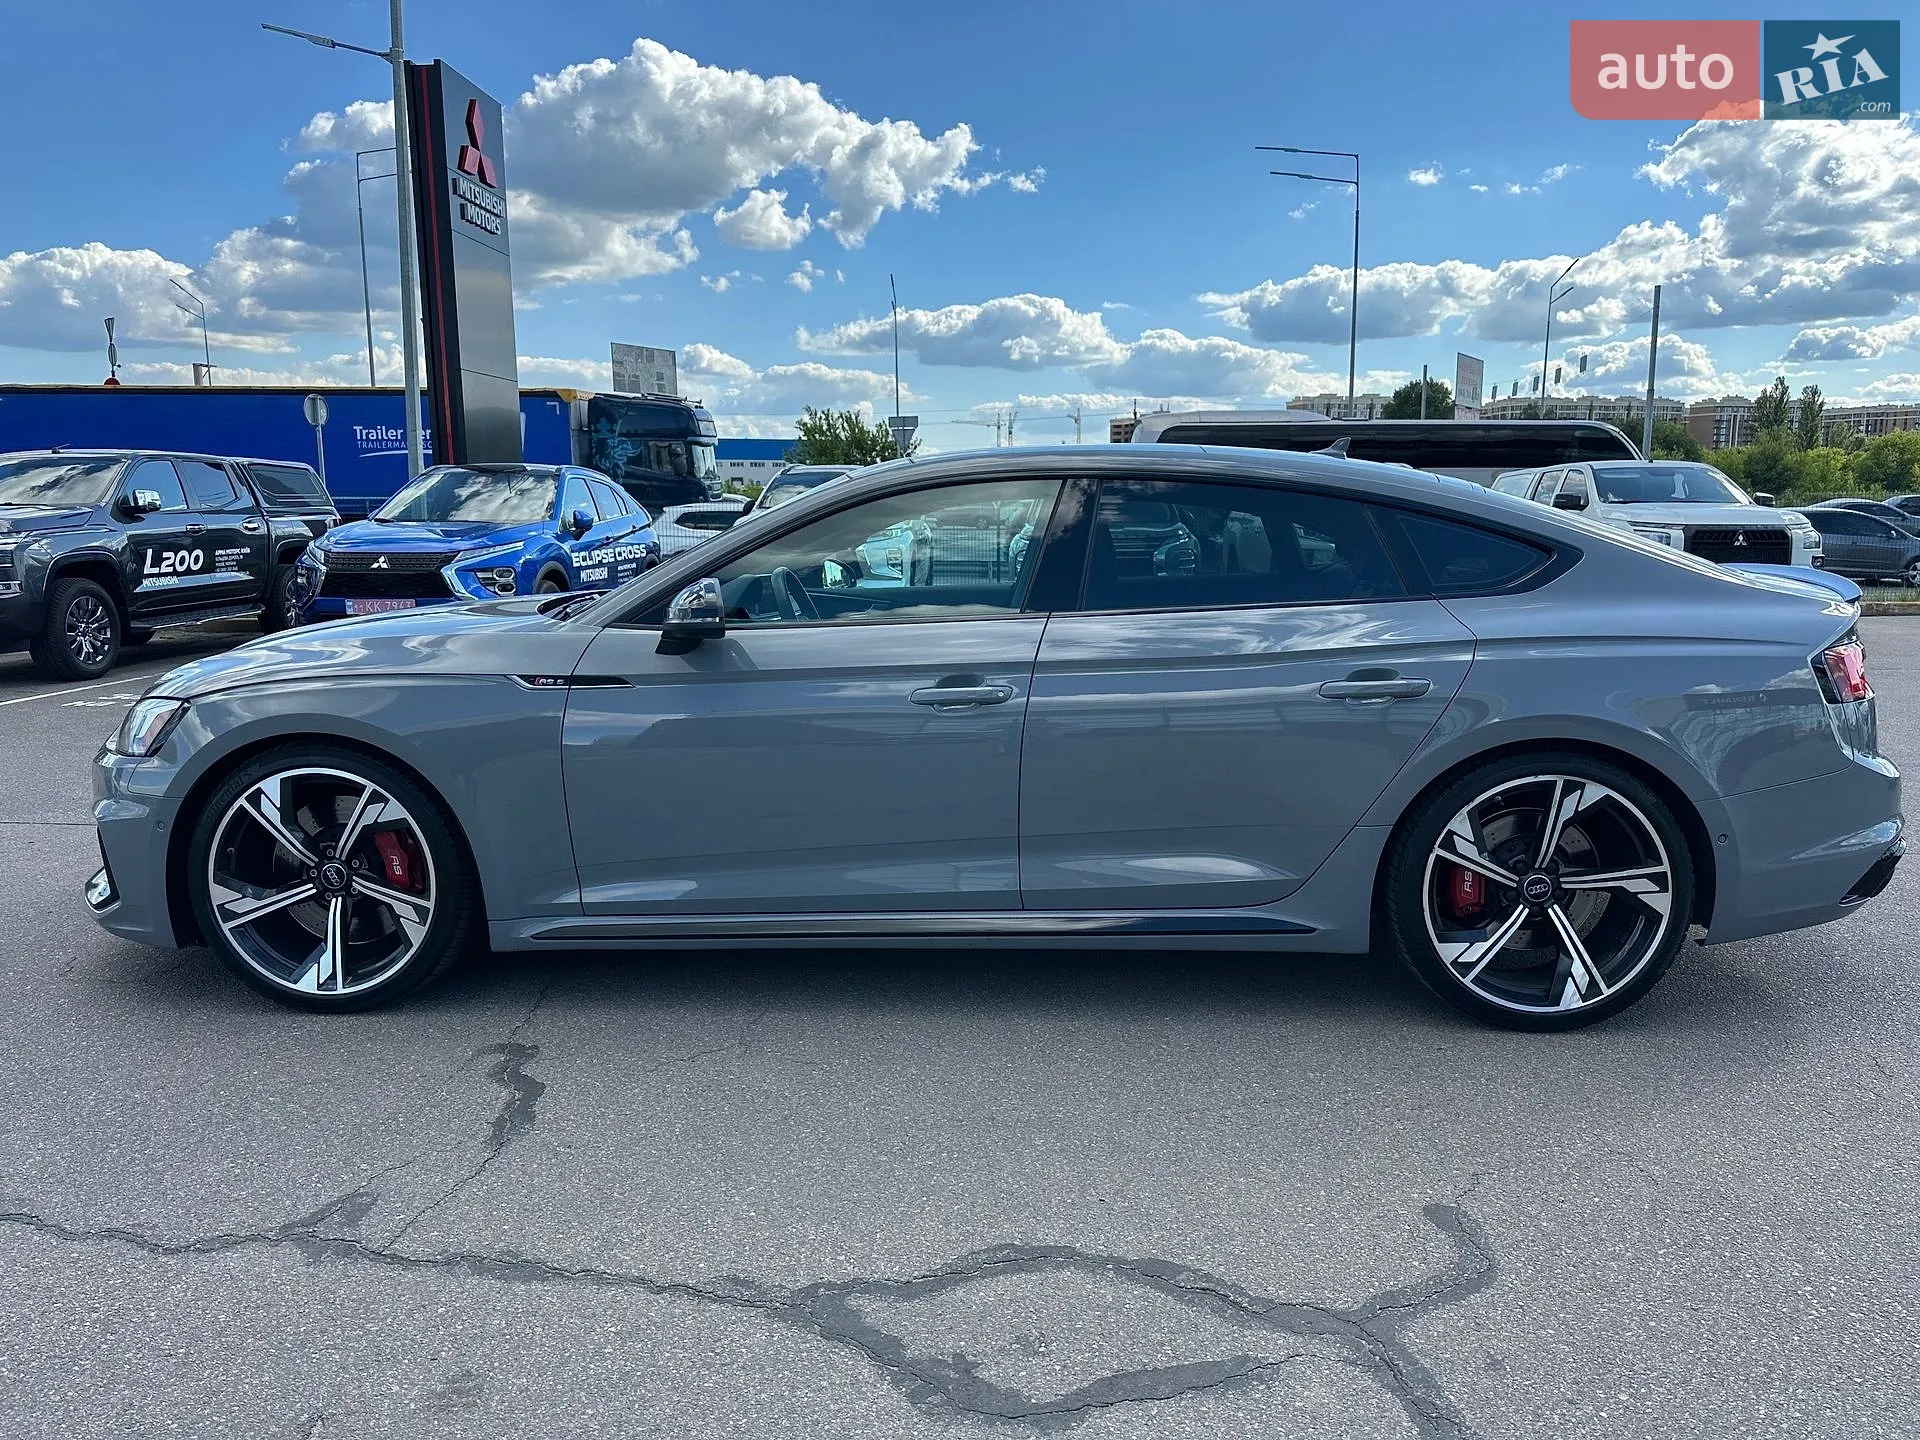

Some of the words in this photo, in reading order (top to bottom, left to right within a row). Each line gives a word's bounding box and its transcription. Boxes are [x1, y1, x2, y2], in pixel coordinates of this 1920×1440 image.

[456, 177, 505, 218] MITSUBISHI
[464, 204, 502, 236] MOTORS
[353, 425, 404, 440] Trailer
[143, 548, 204, 575] L200
[571, 548, 615, 568] ECLIPSE
[615, 543, 647, 562] CROSS
[142, 575, 180, 588] MITSUBISHI
[580, 566, 608, 583] MITSUBISHI
[390, 855, 403, 876] RS
[1463, 870, 1474, 893] RS
